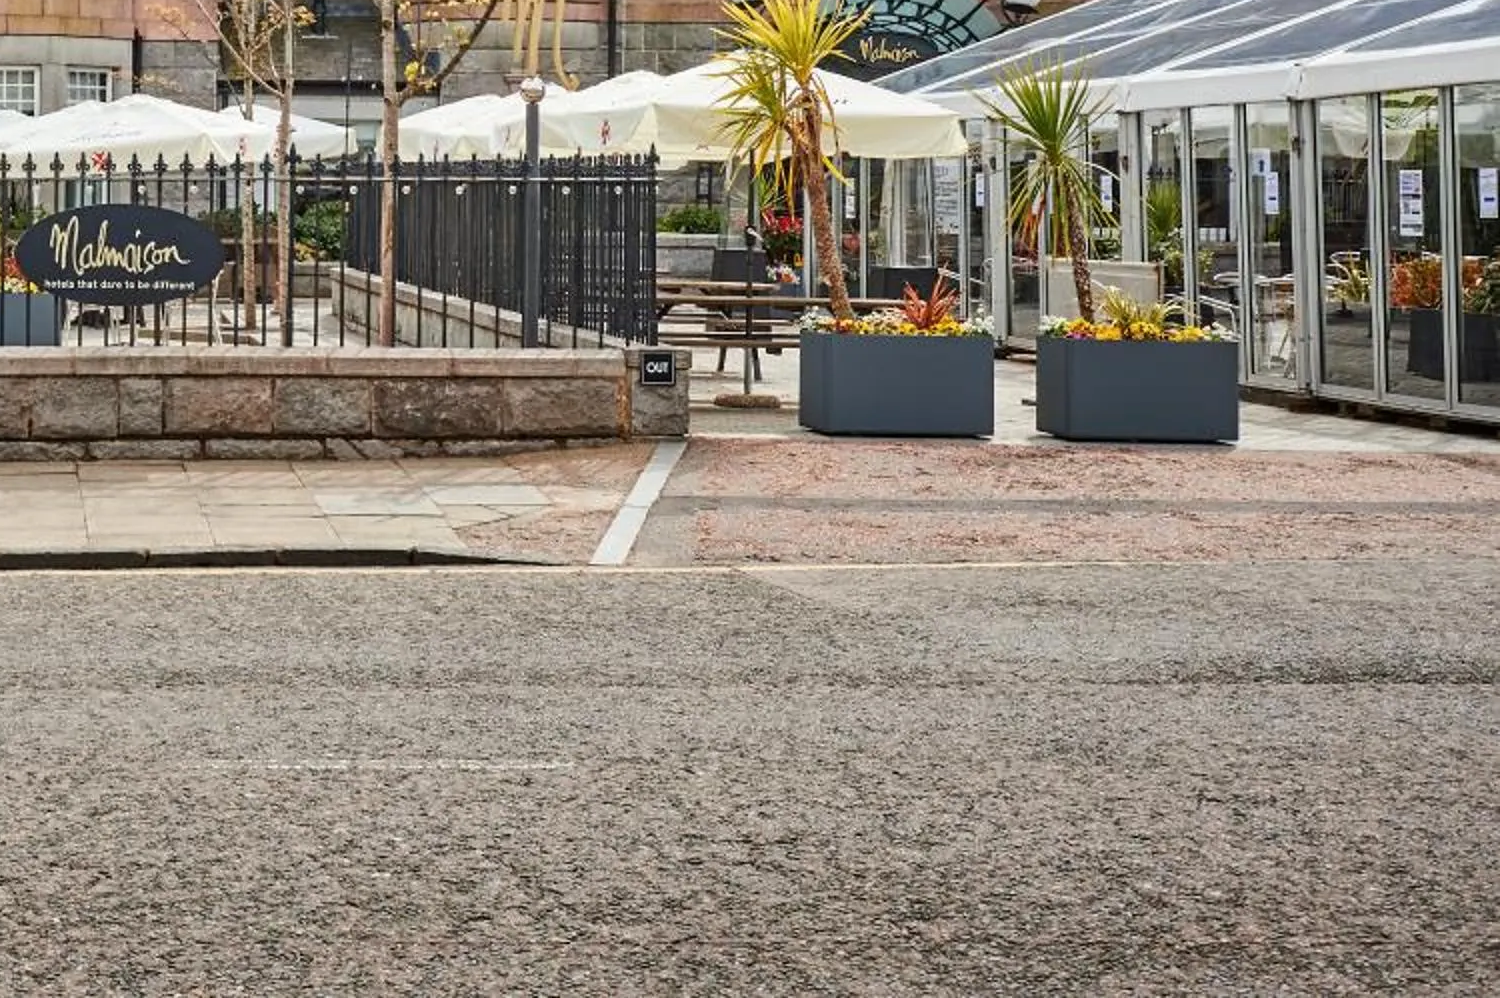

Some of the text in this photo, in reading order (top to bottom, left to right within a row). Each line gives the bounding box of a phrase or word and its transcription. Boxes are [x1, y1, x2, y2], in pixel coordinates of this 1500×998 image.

[50, 215, 191, 276] Malmaison
[44, 279, 195, 291] hotels that dare to be different
[646, 361, 669, 373] OUT
